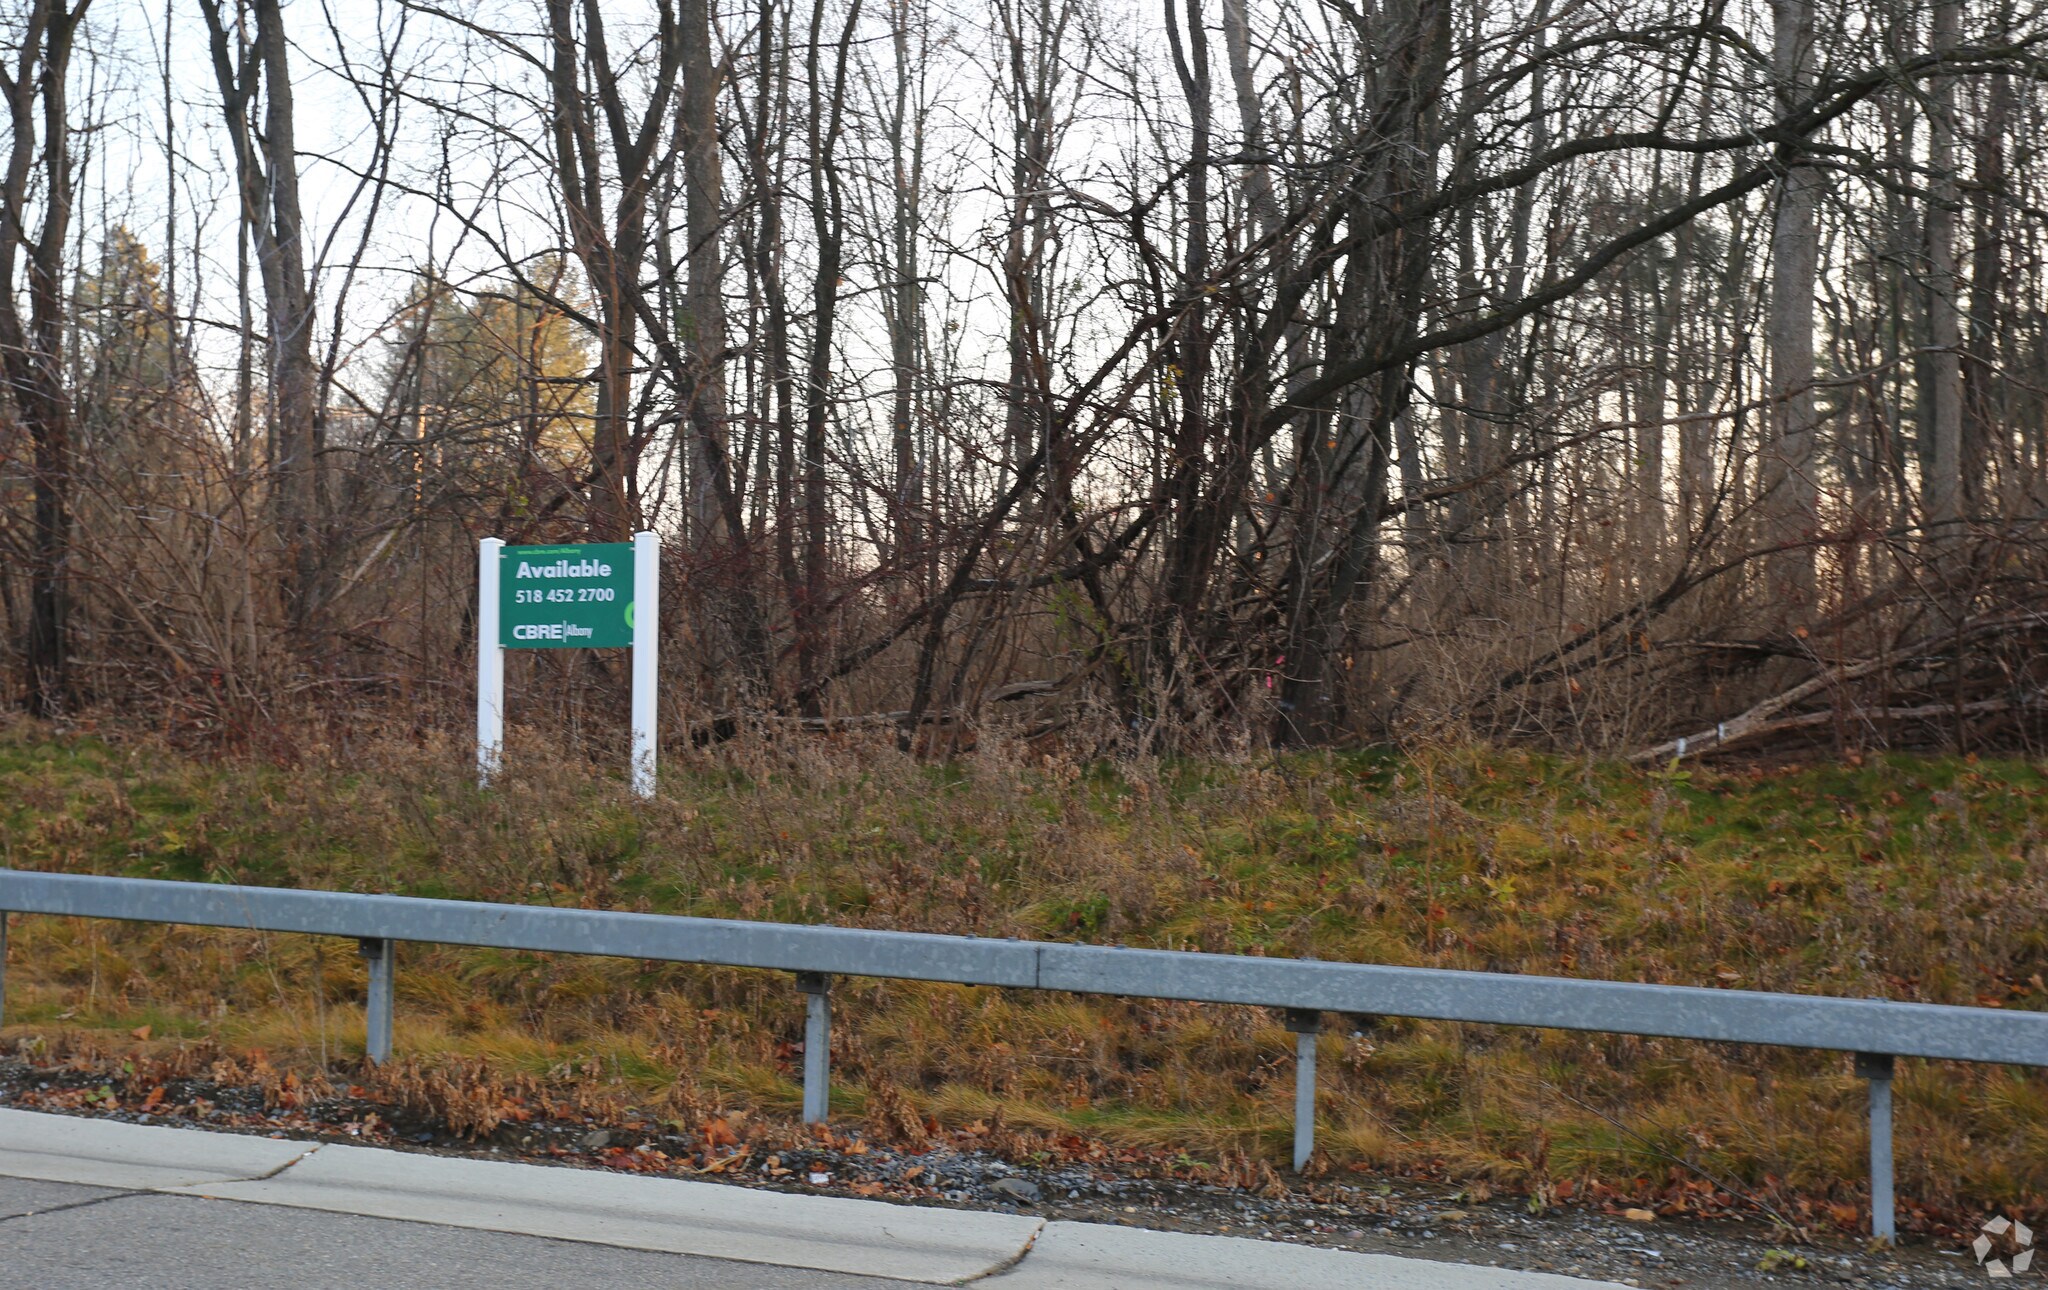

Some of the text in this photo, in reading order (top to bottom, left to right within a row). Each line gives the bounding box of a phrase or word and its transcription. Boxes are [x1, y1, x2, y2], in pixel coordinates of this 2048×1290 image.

[516, 559, 612, 578] Available
[515, 588, 615, 603] 518 452 2700
[513, 624, 563, 640] CBRE
